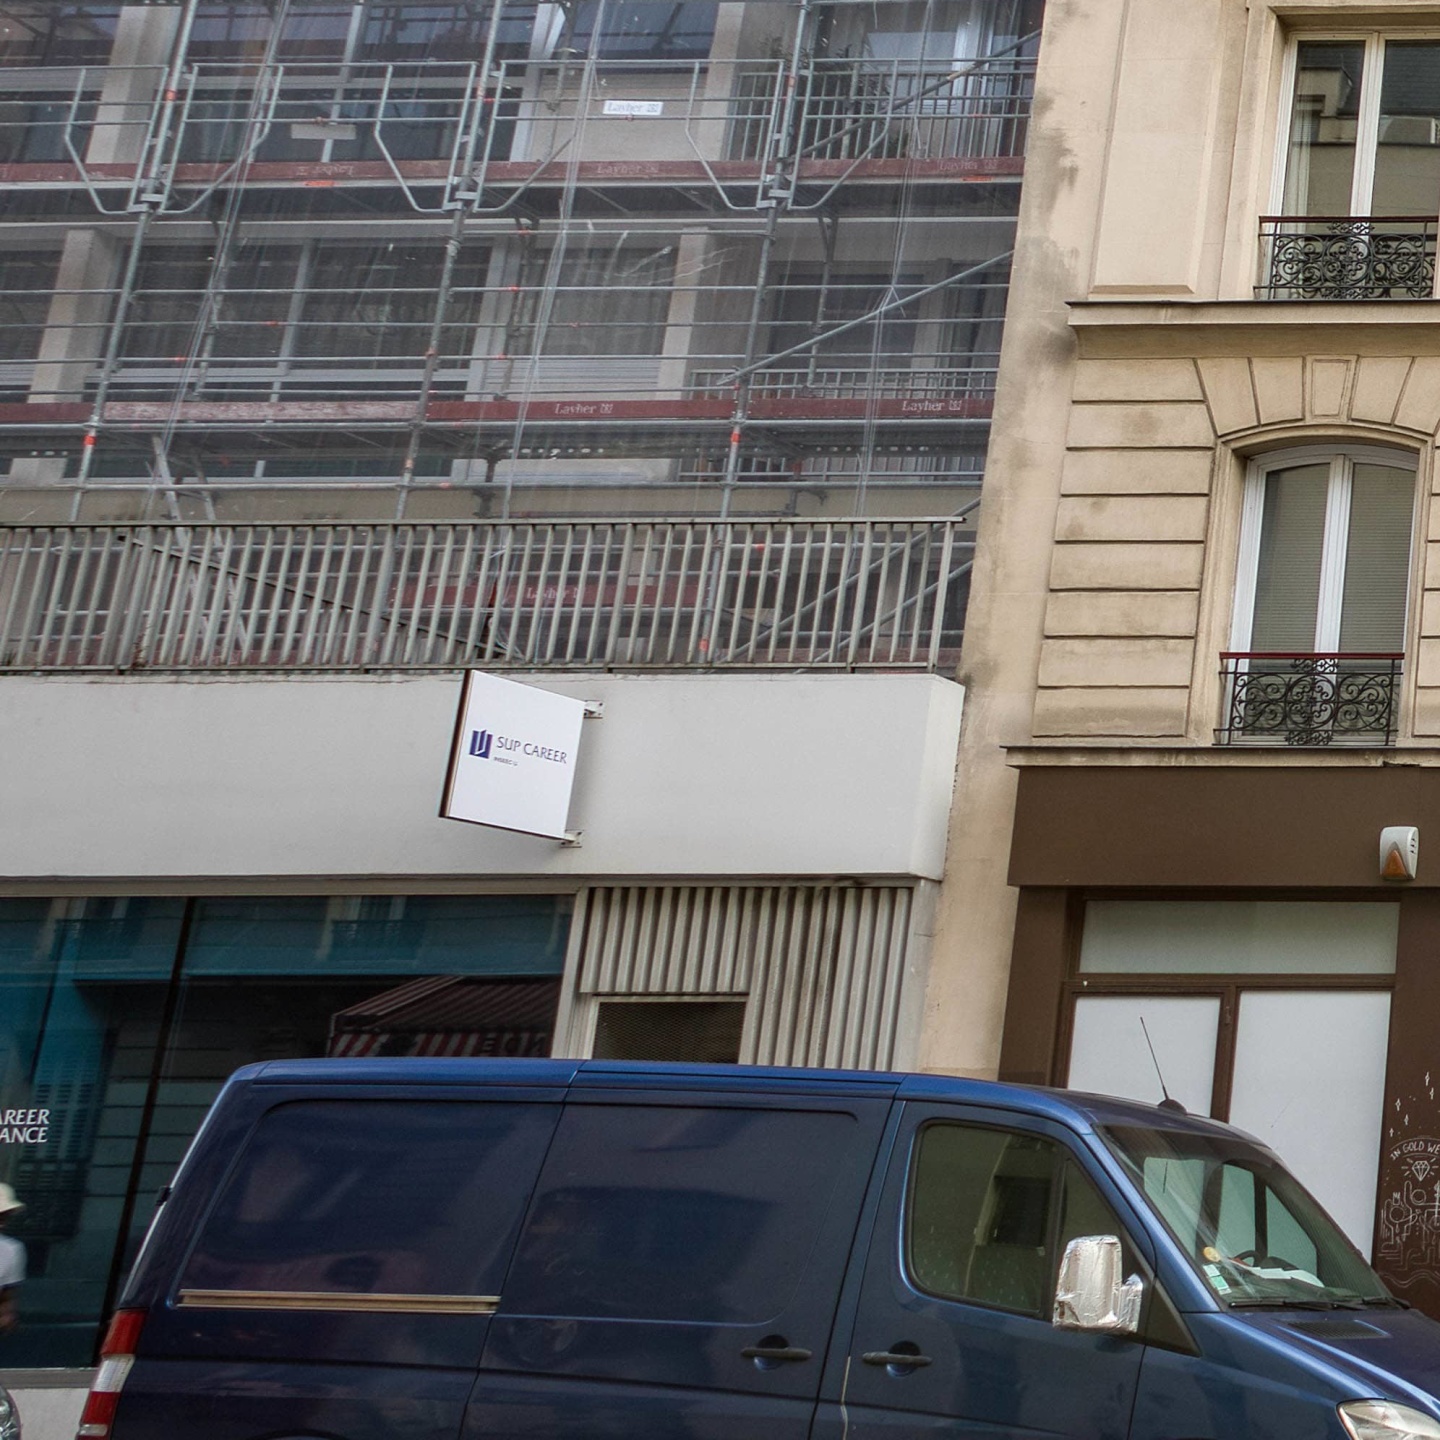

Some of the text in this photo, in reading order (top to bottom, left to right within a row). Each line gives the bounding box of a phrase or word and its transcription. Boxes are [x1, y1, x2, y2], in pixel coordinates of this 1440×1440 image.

[555, 403, 597, 415] Layher
[902, 400, 945, 412] Layher
[496, 736, 567, 764] SUP CAREER
[0, 1109, 50, 1125] REER
[1389, 1148, 1401, 1161] IN
[1402, 1141, 1425, 1153] GOLD
